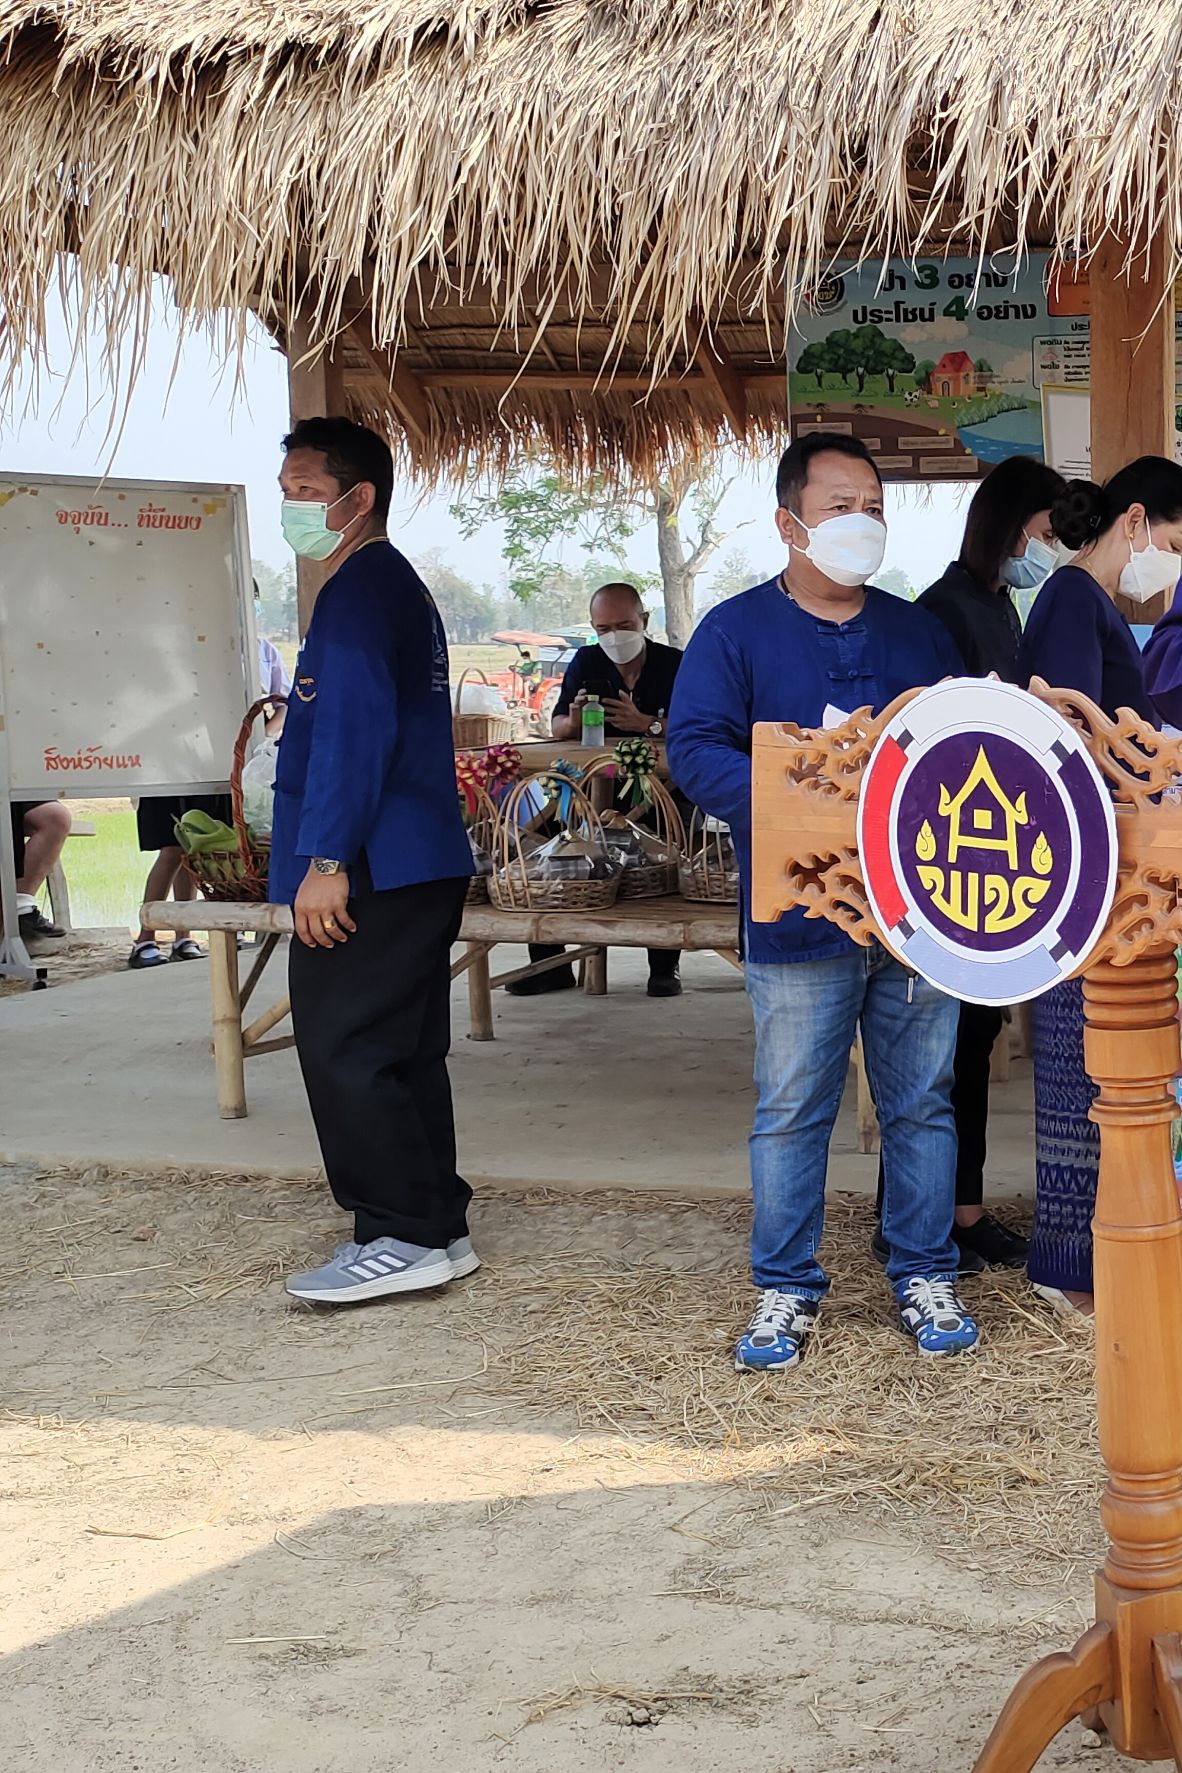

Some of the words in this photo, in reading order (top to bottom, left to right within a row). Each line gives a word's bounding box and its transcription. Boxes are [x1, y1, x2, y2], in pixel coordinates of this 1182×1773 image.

[914, 264, 940, 290] 3
[942, 295, 969, 322] 4
[976, 300, 1037, 321] อย่าง
